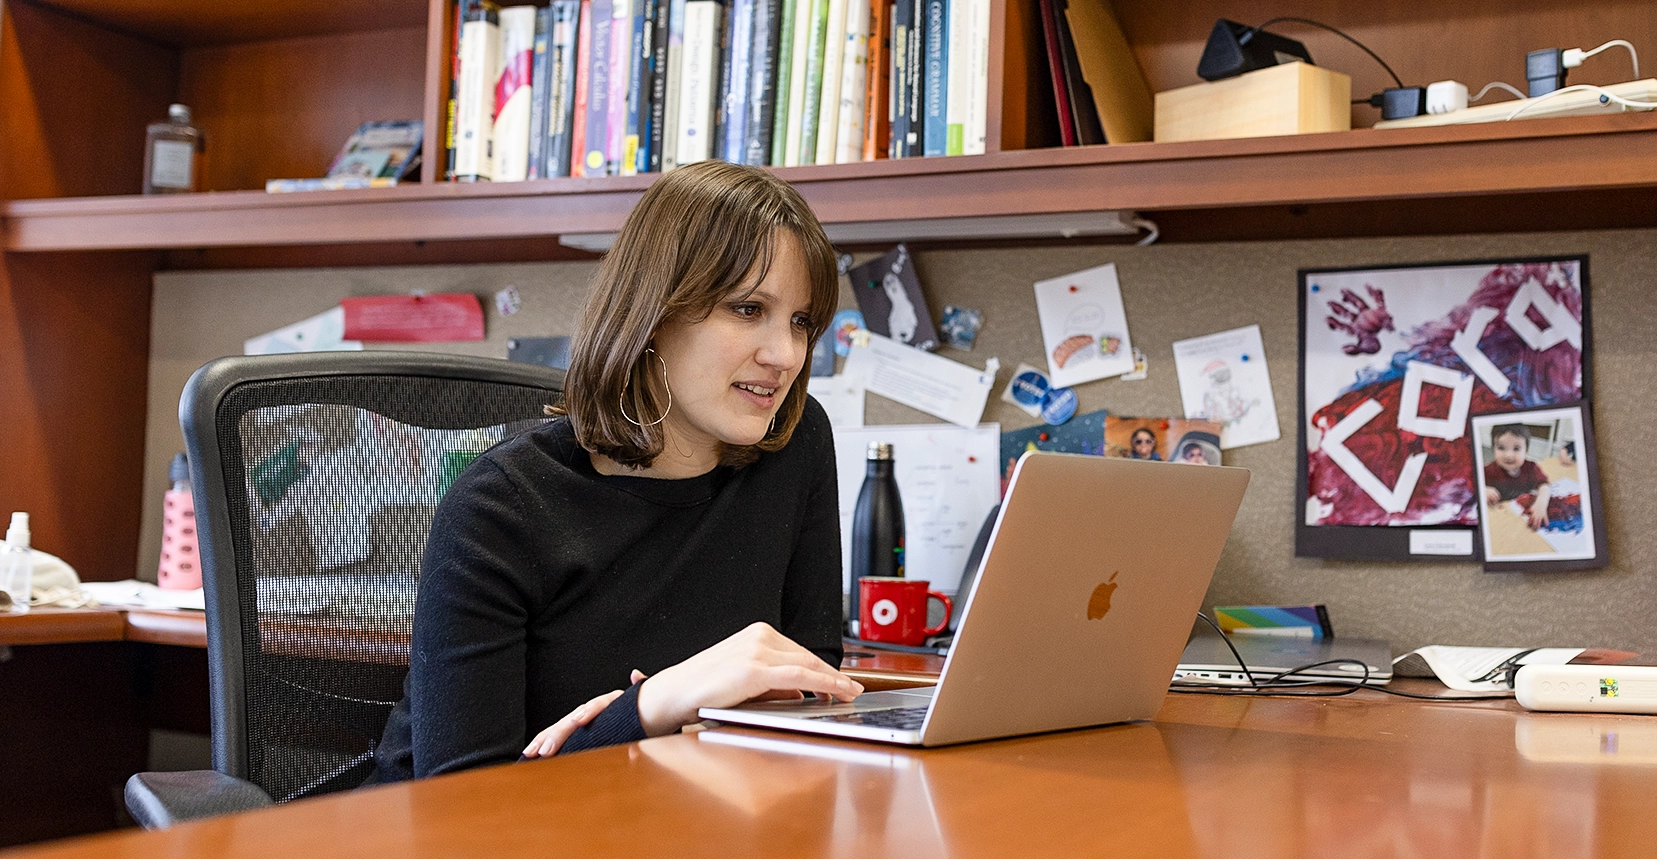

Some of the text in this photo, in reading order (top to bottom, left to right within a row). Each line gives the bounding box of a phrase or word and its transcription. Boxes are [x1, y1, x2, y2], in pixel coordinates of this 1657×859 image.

[595, 19, 609, 59] Vector
[655, 47, 666, 73] WORD
[929, 1, 942, 118] COGNITIVE GRAMMAR
[592, 60, 608, 112] Calculus
[653, 79, 663, 98] AND
[688, 78, 701, 125] Patterns
[651, 103, 662, 141] OBJECT
